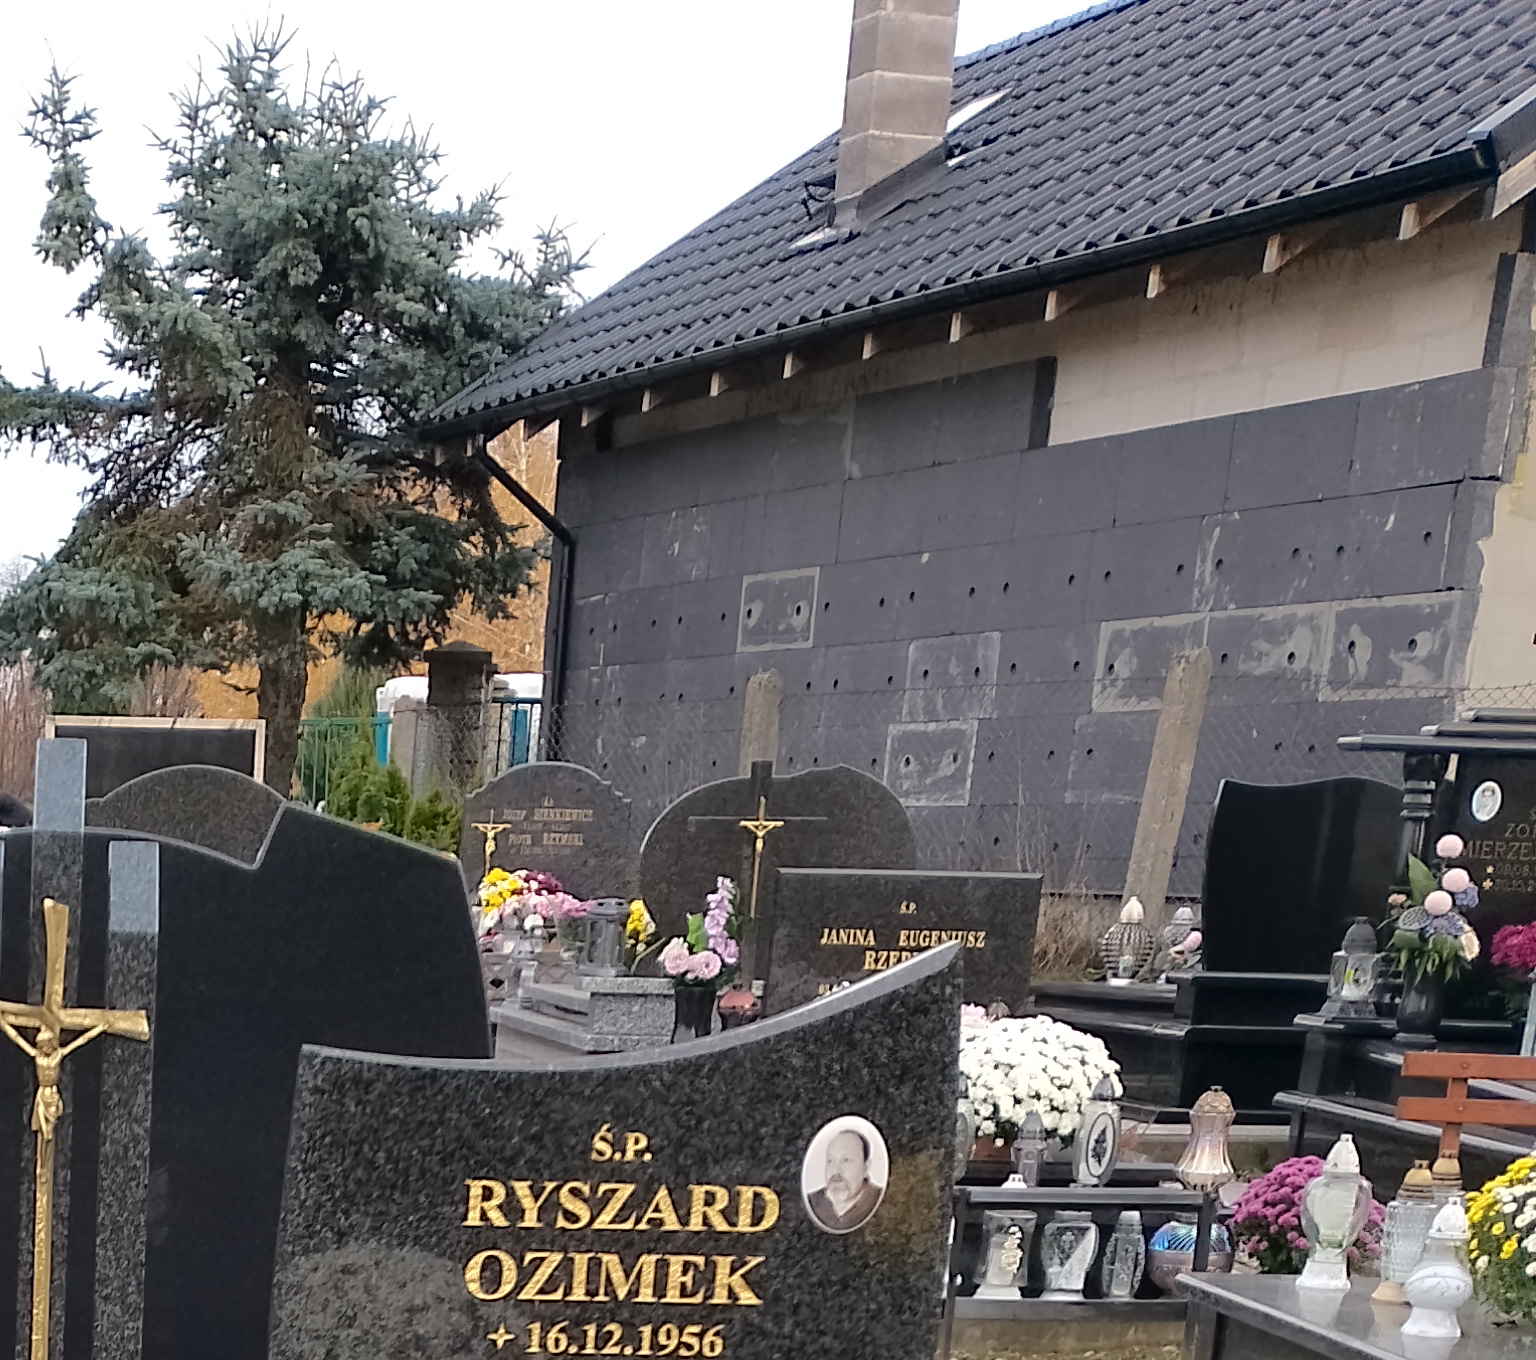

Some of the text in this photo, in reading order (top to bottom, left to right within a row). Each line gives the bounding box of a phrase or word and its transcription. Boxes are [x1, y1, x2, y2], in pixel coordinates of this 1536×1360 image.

[899, 900, 917, 914] Ś.P.
[820, 928, 876, 945] JANINA
[590, 1122, 654, 1162] Ś.P.
[461, 1178, 781, 1233] RYSZARD
[464, 1249, 767, 1306] OZIMEK
[524, 1320, 726, 1357] 16.12.1956
